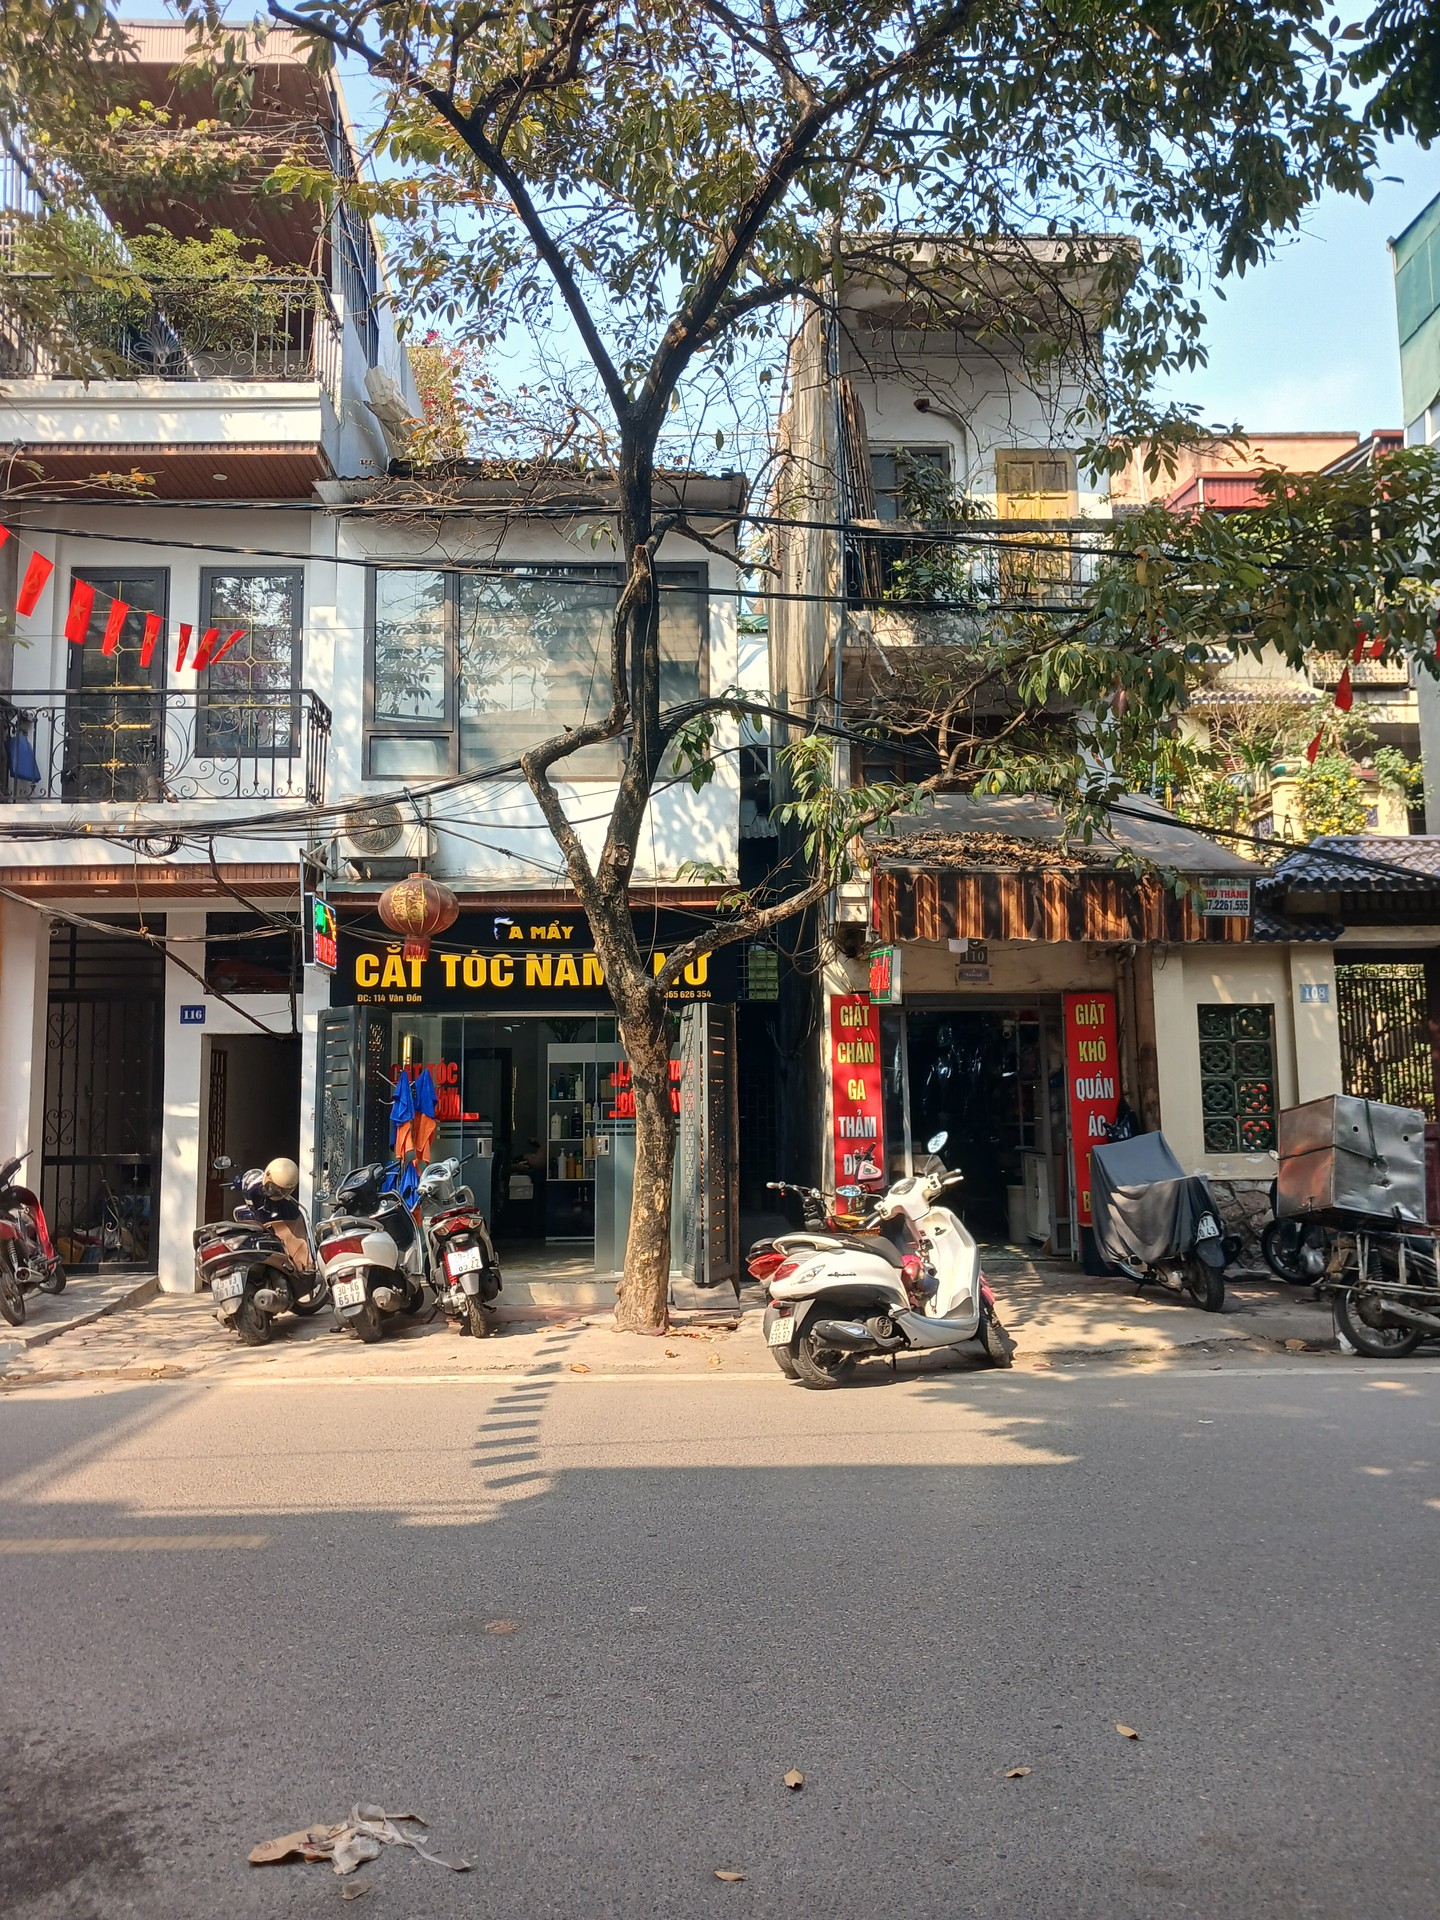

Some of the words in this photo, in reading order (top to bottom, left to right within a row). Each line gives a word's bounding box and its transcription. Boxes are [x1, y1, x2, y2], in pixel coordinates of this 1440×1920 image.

[355, 941, 428, 988] CẮT
[440, 949, 515, 988] TÓC
[963, 950, 985, 962] 110
[373, 994, 386, 1003] 114
[680, 990, 695, 999] 626
[696, 990, 712, 999] 354
[1304, 986, 1326, 1000] 108
[183, 1009, 203, 1020] 116
[840, 1001, 870, 1031] GIẶT
[1075, 999, 1106, 1030] GIẶT
[837, 1037, 875, 1064] CHĂN
[1078, 1035, 1107, 1062] KHÔ
[847, 1078, 867, 1101] GA
[1075, 1069, 1115, 1102] QUẦN
[838, 1108, 877, 1138] THẢM
